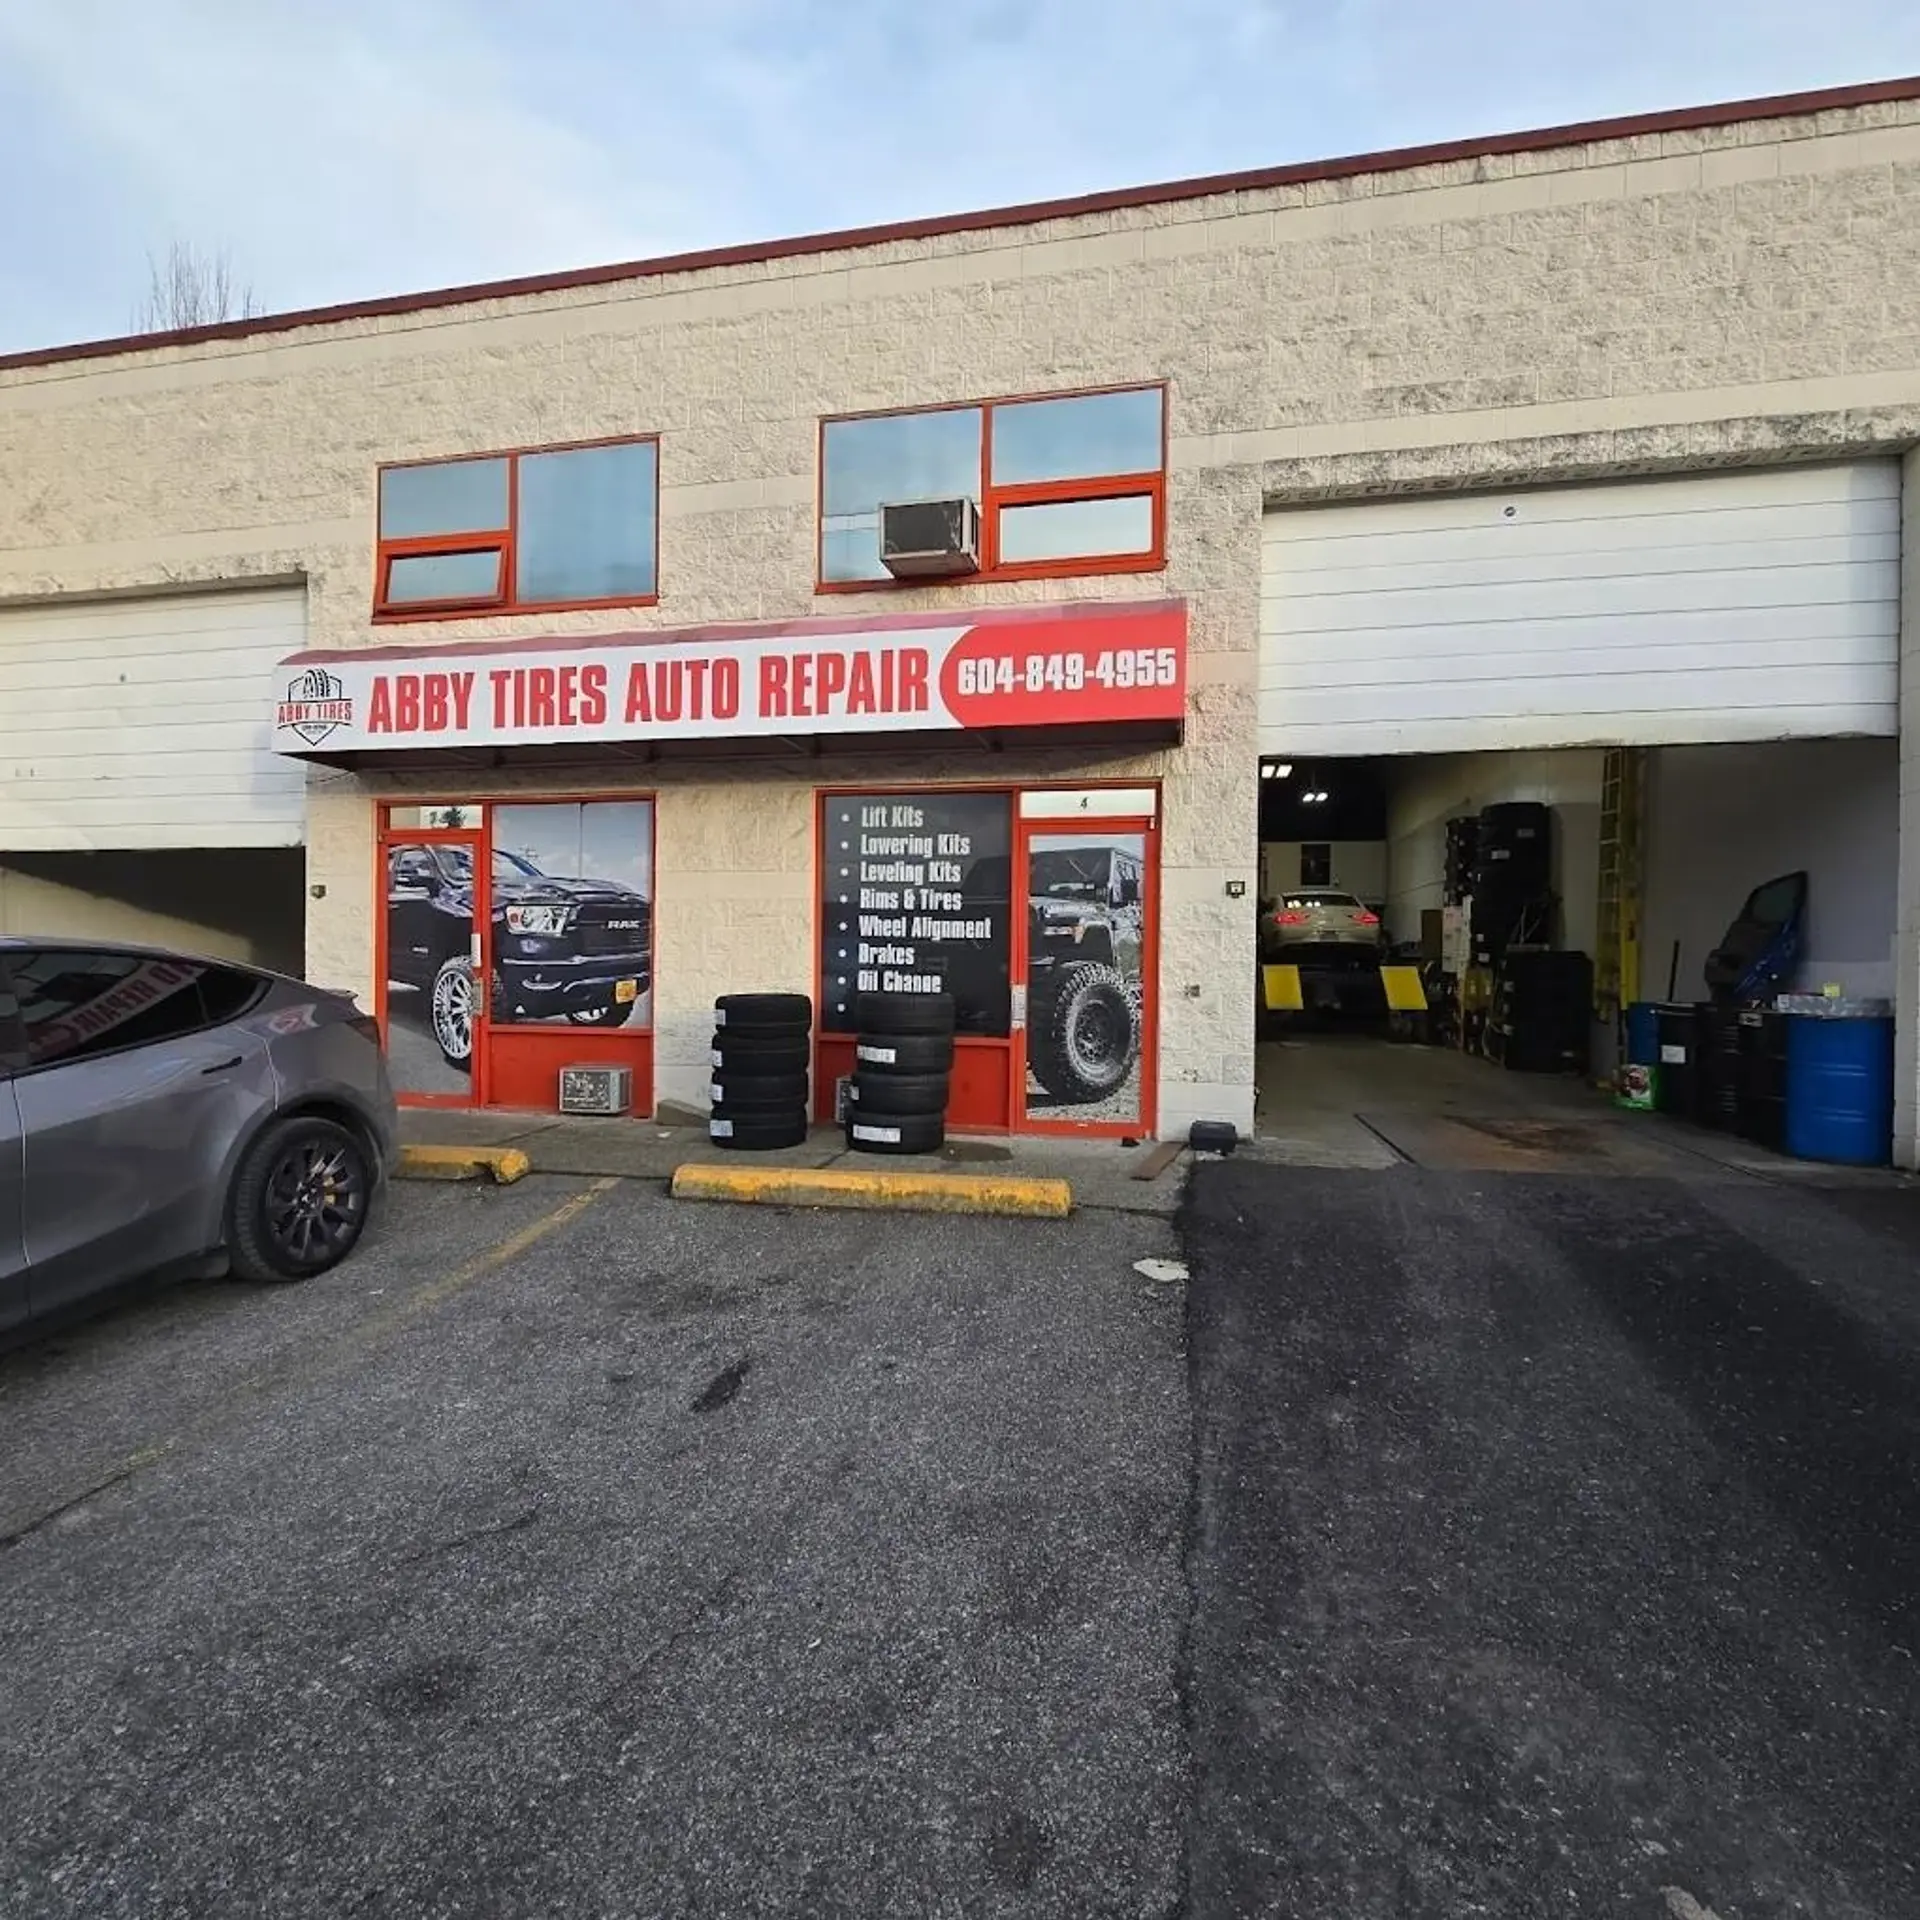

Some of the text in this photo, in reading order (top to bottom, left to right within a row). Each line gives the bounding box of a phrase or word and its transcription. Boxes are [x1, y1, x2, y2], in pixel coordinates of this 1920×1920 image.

[368, 647, 1176, 734] ABBY TIRES AUTO REPAIR 604-849-4955
[278, 702, 353, 723] ABBY TIRES
[862, 805, 924, 828] Lift Kits
[861, 833, 971, 858] Lowering Kits
[860, 860, 962, 886] Leveling Kits
[860, 888, 962, 911] Rims & Tires
[858, 915, 992, 941] Wheel Alignment
[858, 943, 915, 965] Brakes
[857, 969, 942, 994] Oil Change
